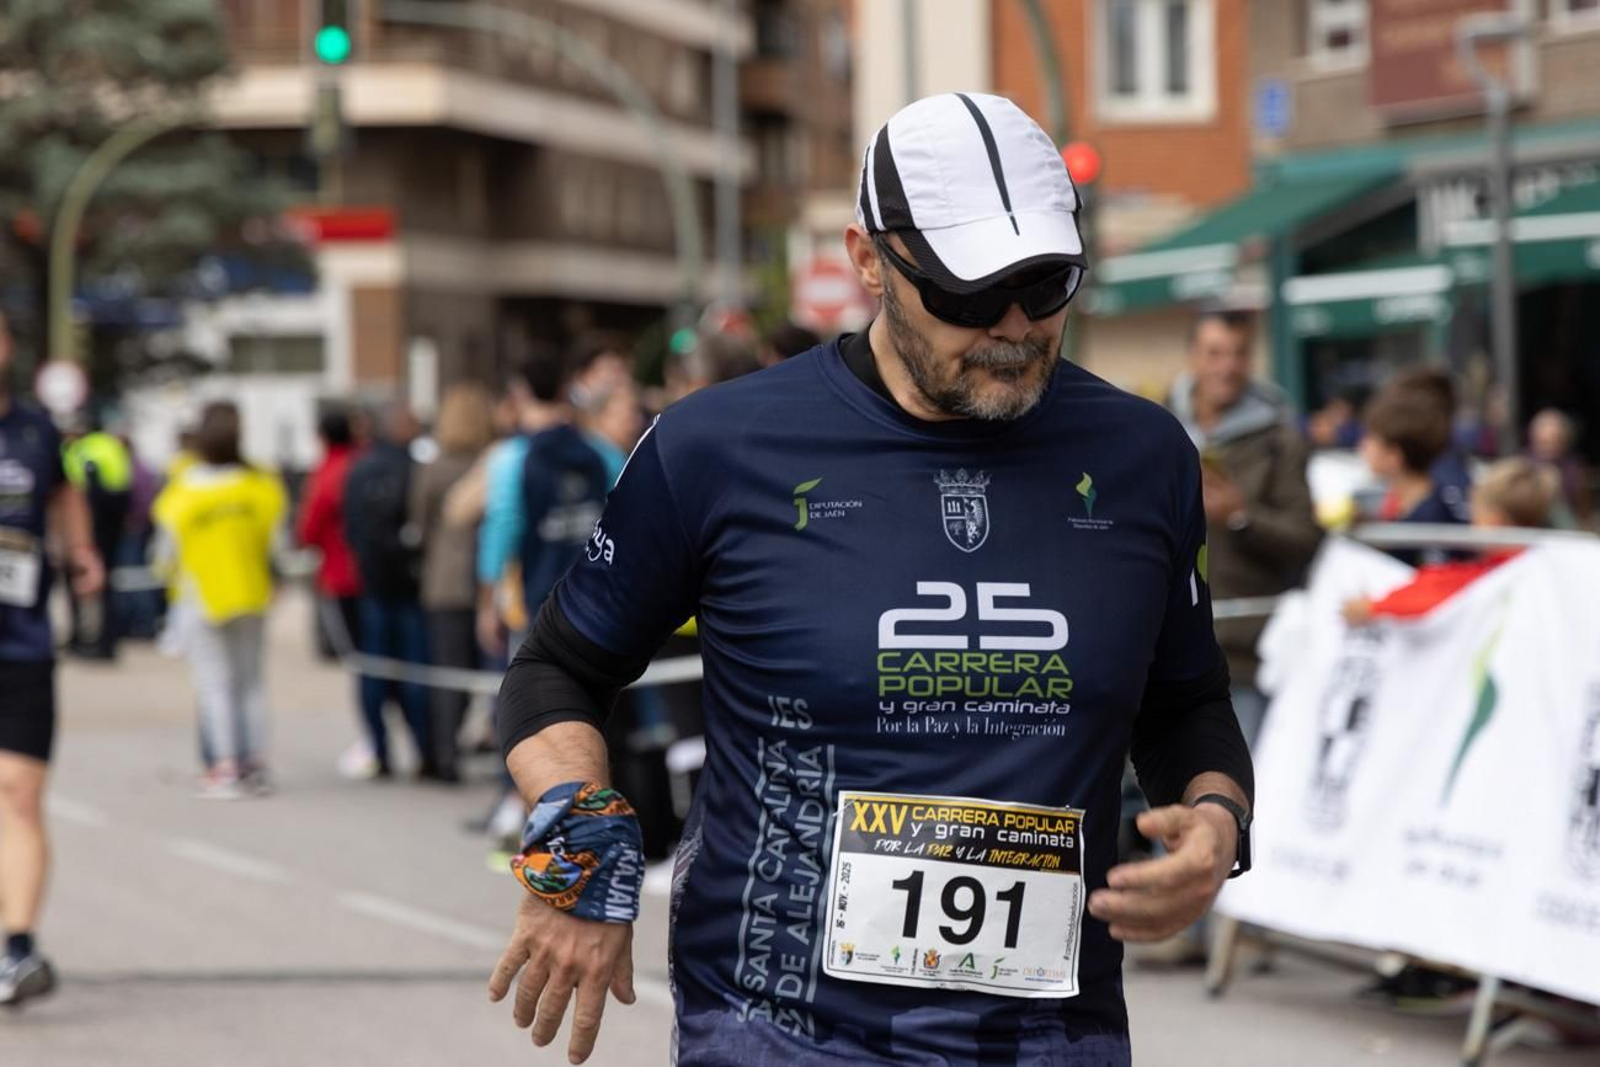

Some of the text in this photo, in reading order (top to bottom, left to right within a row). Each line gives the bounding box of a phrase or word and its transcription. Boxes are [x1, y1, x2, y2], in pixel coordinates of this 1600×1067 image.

[878, 581, 1069, 650] 25
[877, 652, 1069, 675] CARRERA
[878, 675, 1073, 699] POPULAR
[768, 695, 813, 730] IES
[879, 699, 1071, 714] y gran caminata
[876, 716, 1066, 740] Por la Paz y la Integración
[850, 801, 1075, 836] XXV CARRERA POPULAR
[911, 822, 1074, 848] y gran caminata
[743, 739, 792, 993] SANTA CATALINA
[874, 838, 902, 851] POR
[904, 841, 924, 855] LA
[926, 843, 952, 858] PAZ
[966, 847, 986, 862] LA
[775, 745, 824, 999] DE ALEJANDRÍA
[836, 919, 845, 929] 16
[841, 861, 852, 884] 2025
[892, 870, 1026, 949] 191
